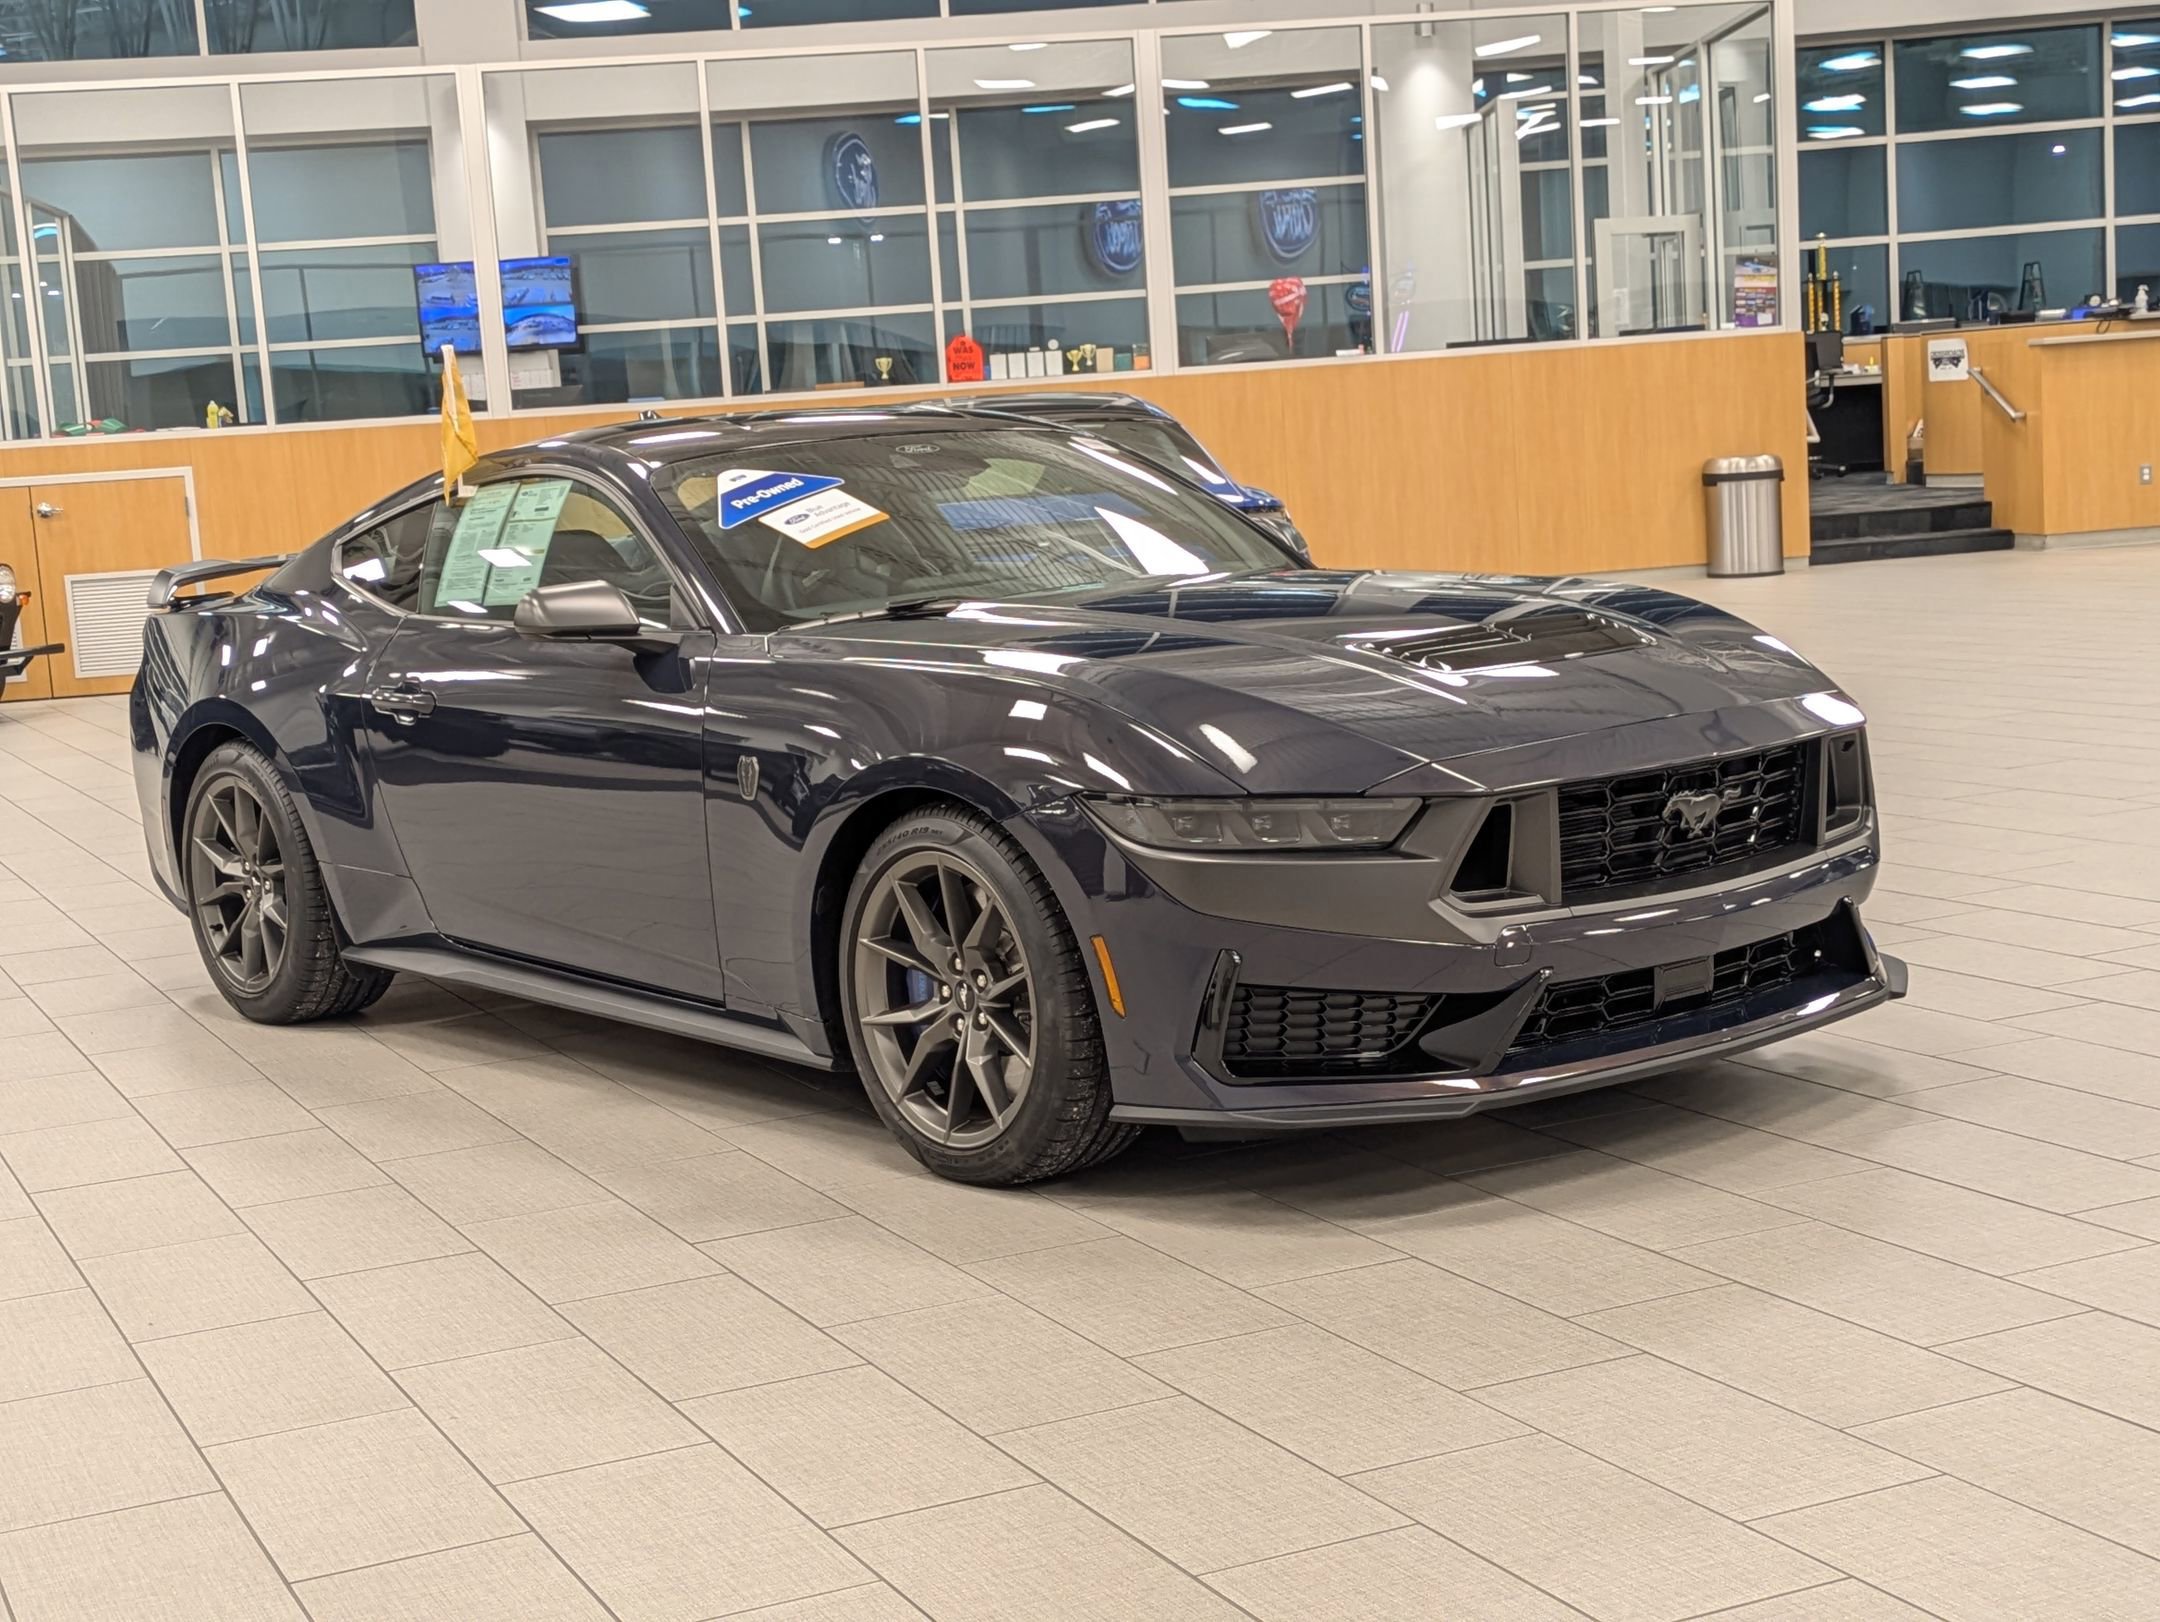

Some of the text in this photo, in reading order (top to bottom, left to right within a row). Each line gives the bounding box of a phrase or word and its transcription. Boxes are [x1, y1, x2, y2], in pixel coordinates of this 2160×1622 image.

[952, 346, 974, 355] WAS
[952, 361, 976, 371] NOW
[730, 477, 804, 510] Pre-Owned
